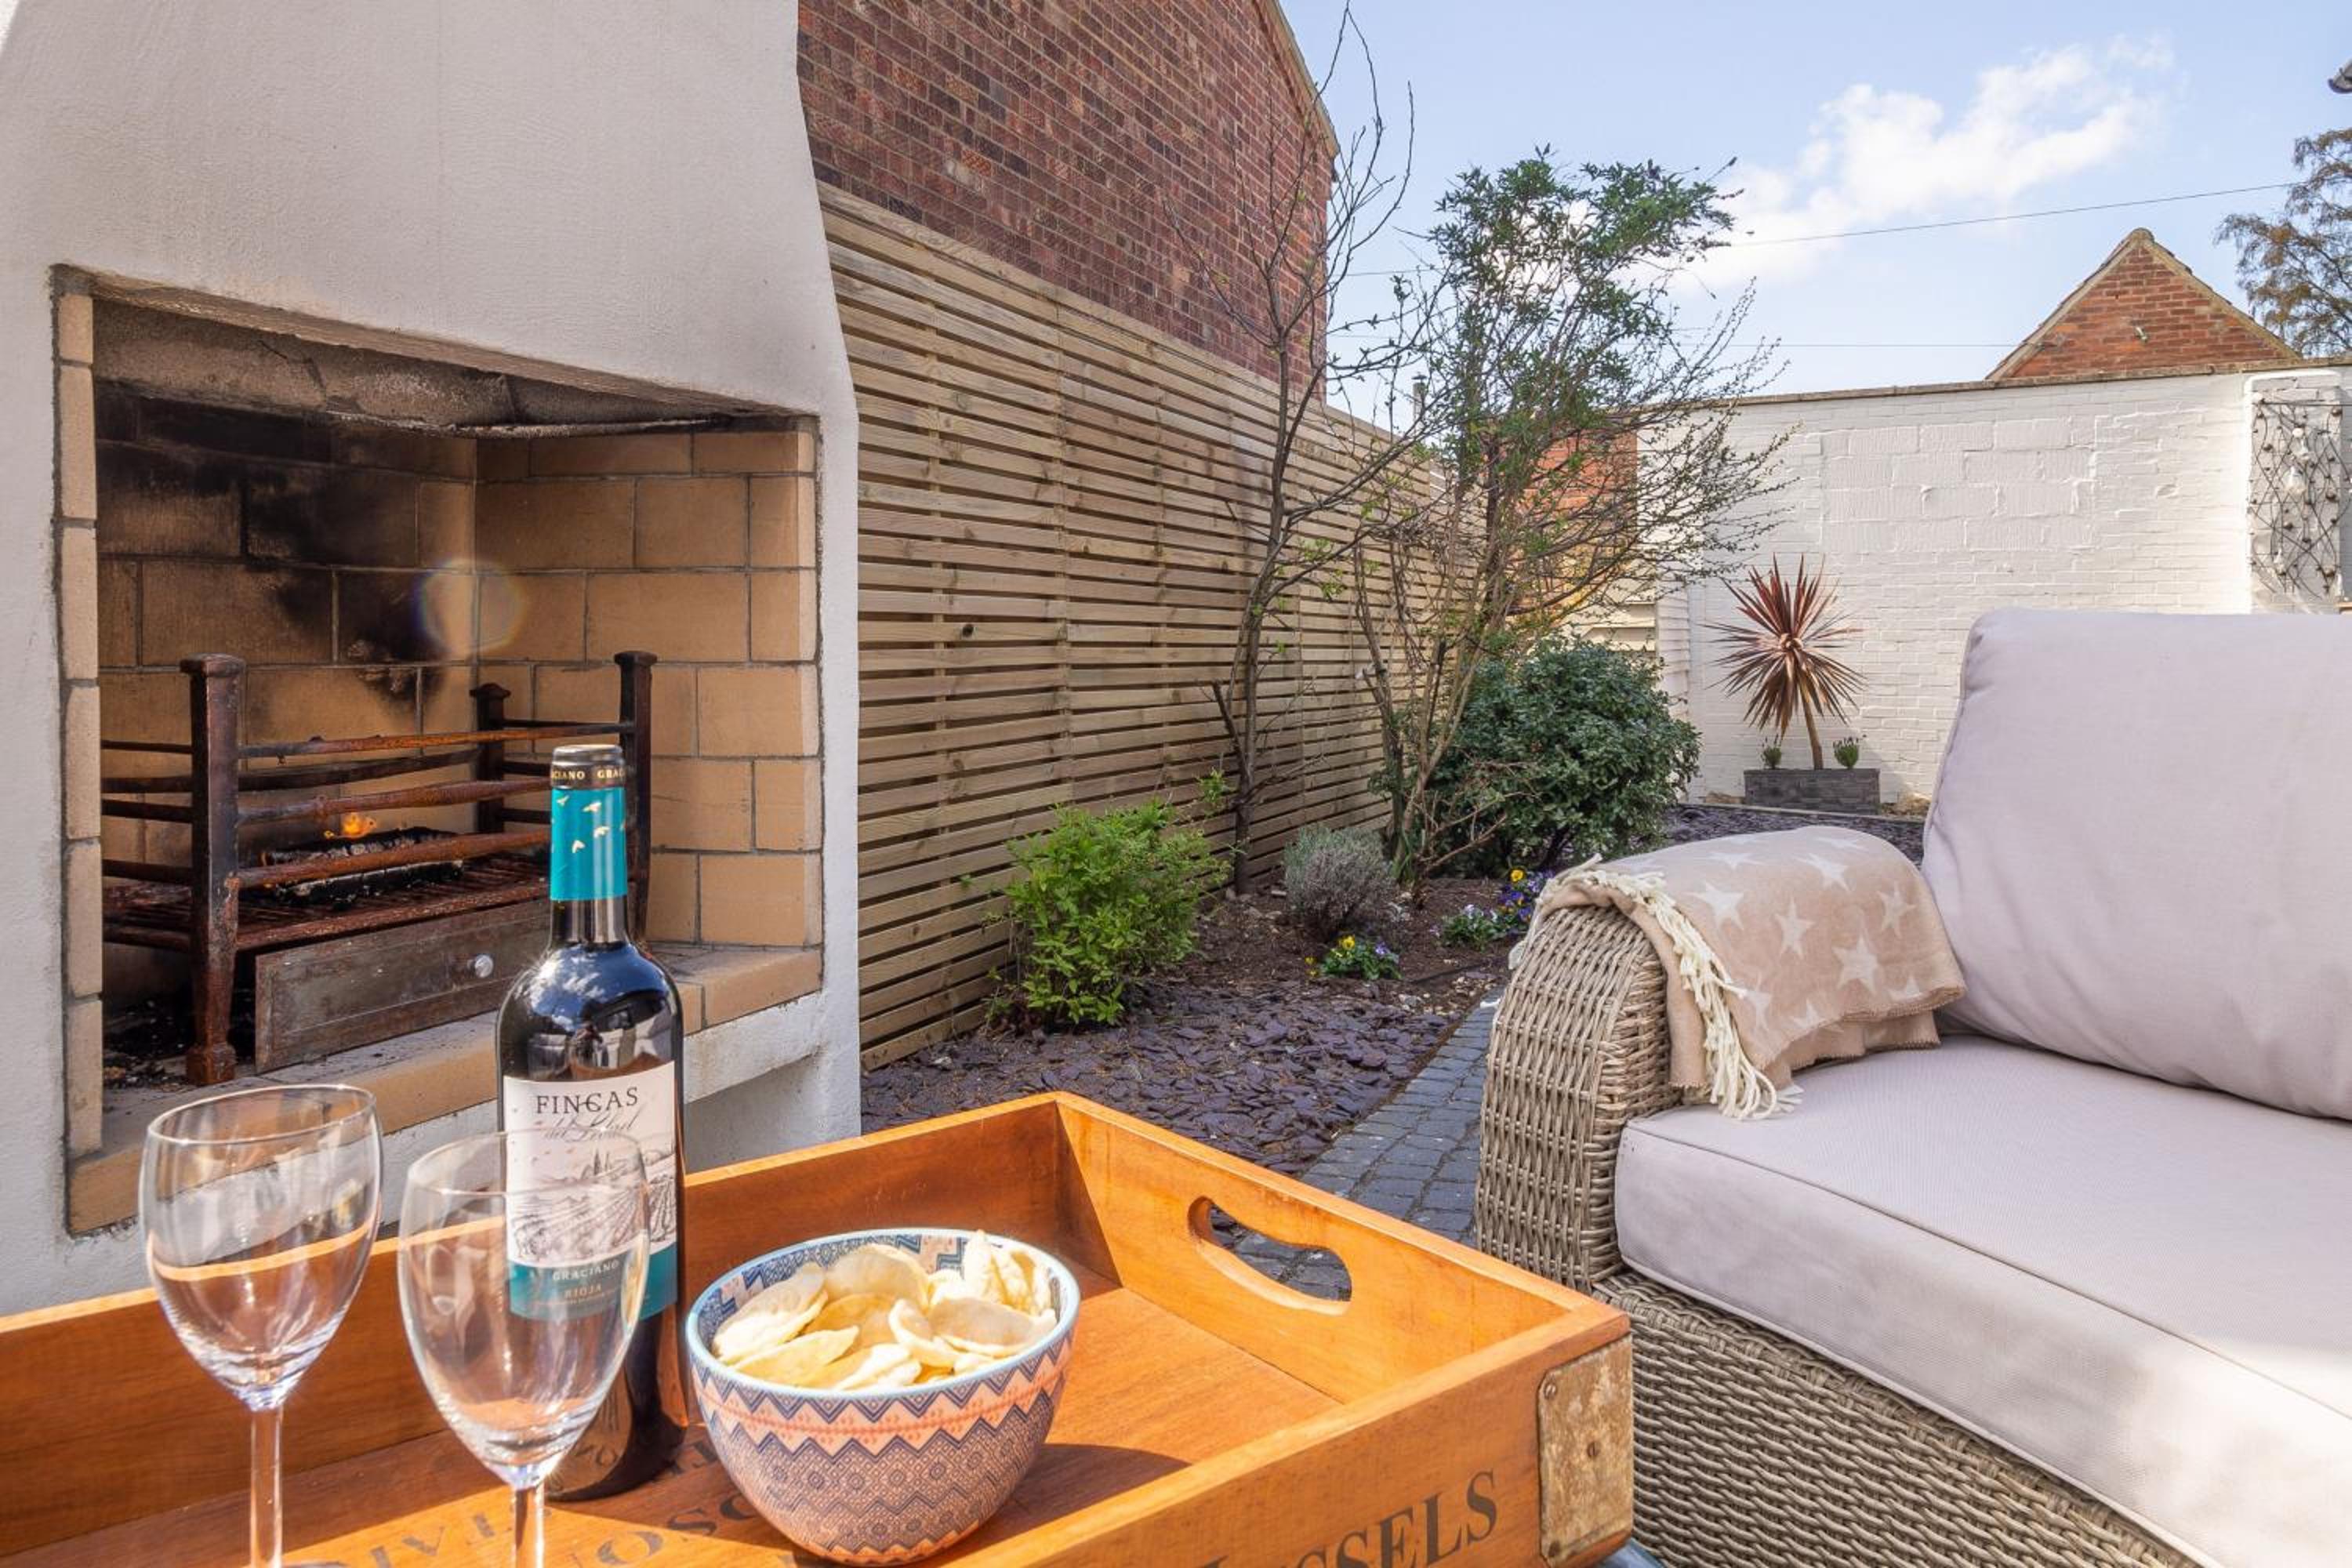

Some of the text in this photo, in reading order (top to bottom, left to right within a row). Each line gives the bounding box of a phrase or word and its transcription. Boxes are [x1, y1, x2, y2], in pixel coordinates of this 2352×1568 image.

[535, 1087, 638, 1114] FINCAS
[552, 1259, 619, 1281] GRACIANO
[564, 1283, 602, 1298] RIOJA
